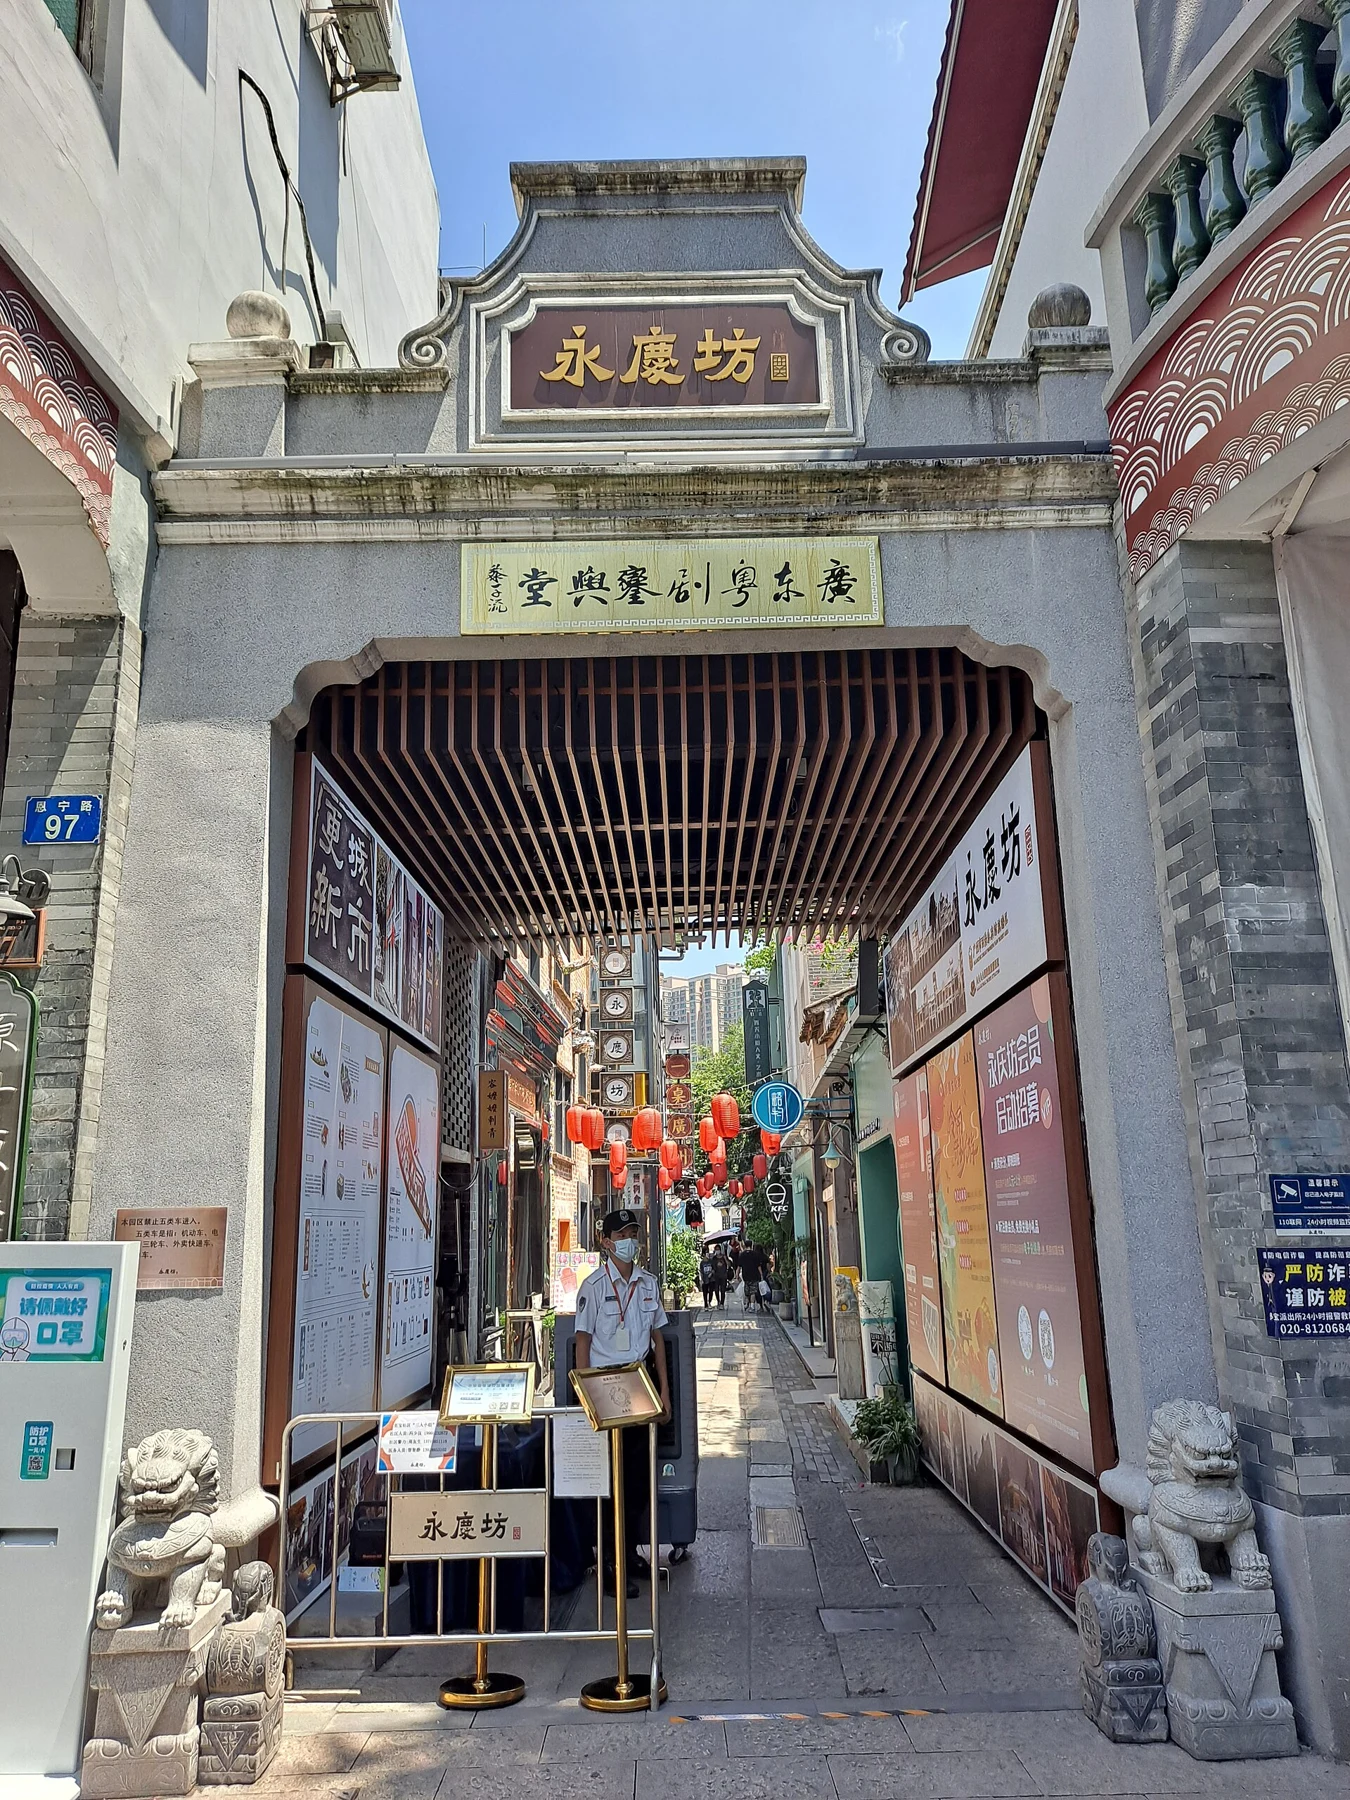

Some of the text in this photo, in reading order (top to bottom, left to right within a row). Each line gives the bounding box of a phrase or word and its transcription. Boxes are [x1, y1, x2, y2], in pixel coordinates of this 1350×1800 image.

[539, 325, 761, 387] 永慶坊
[35, 800, 93, 813] 恩宁路
[45, 815, 79, 840] 97
[964, 801, 1020, 928] 永慶坊
[987, 1024, 1042, 1089] 永庆坊会员
[995, 1081, 1040, 1135] 启动招募
[1307, 1178, 1339, 1187] 温馨提示
[1284, 1263, 1350, 1283] 严防诈
[19, 1297, 88, 1316] 请佩戴好
[1285, 1287, 1347, 1308] 谨防被
[36, 1320, 83, 1346] 口罩
[28, 1436, 48, 1447] 口罩
[29, 1426, 49, 1437] 防护
[418, 1511, 509, 1541] 永慶坊
